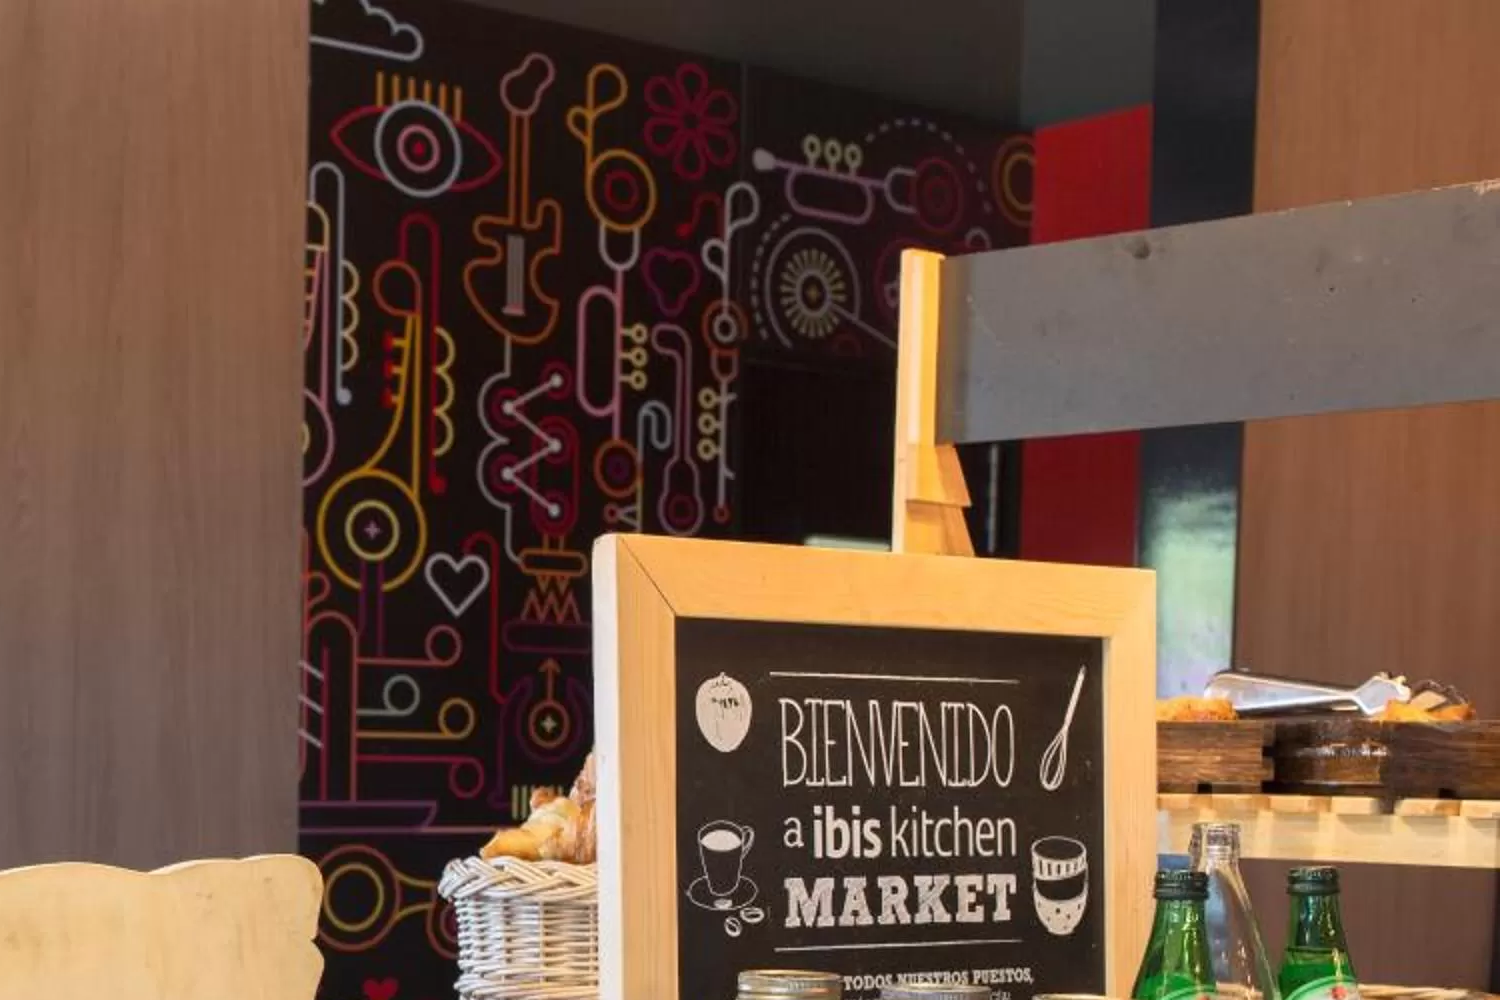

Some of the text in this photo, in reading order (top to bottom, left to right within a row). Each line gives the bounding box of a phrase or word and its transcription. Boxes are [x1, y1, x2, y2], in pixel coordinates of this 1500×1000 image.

[778, 697, 1016, 788] BIENVENIDO
[783, 804, 1018, 859] a ibis kitchen
[783, 873, 1017, 928] MARKET
[843, 973, 893, 992] TODOS
